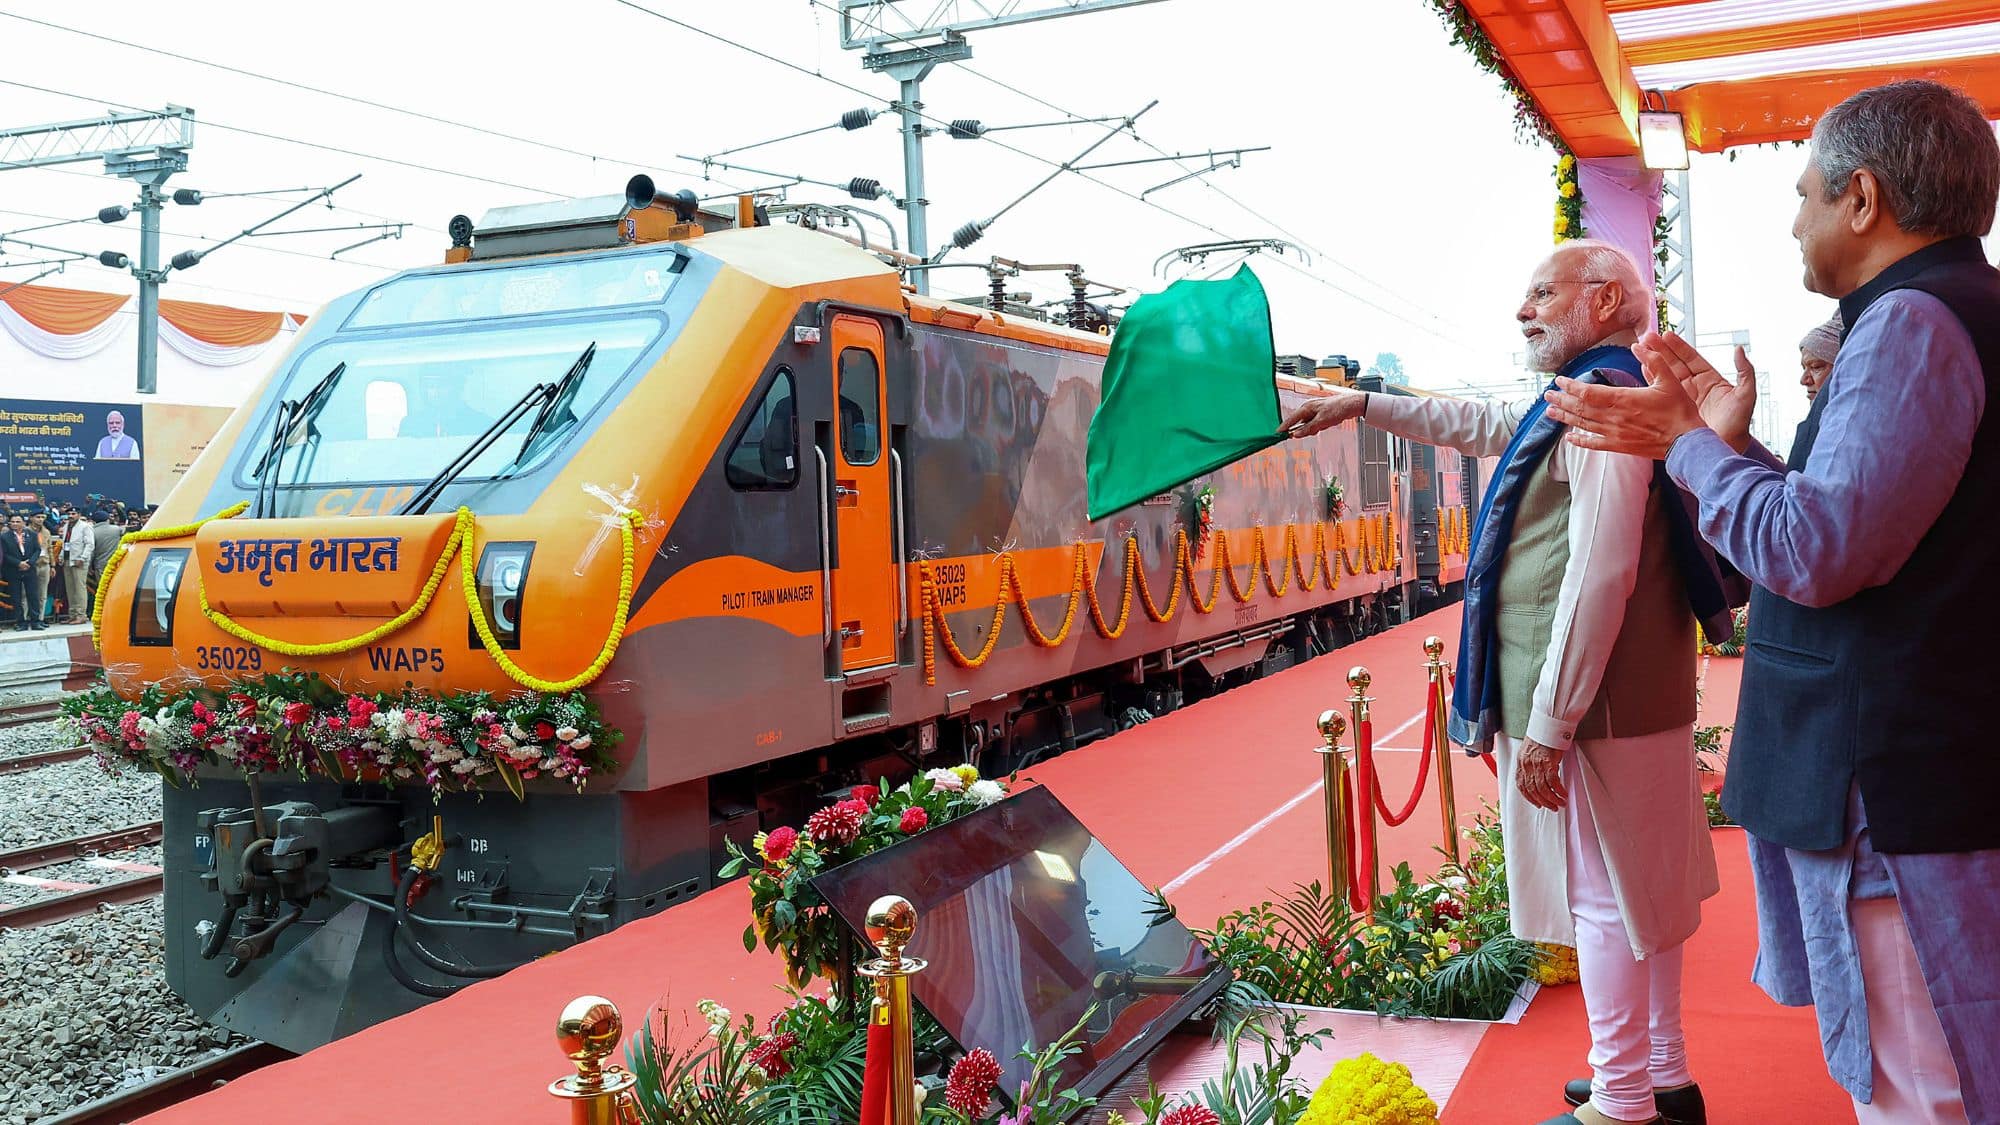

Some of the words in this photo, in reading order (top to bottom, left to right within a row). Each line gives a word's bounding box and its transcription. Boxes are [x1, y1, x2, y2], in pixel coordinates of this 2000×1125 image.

[19, 426, 39, 435] भारत
[40, 425, 50, 435] की
[214, 538, 302, 587] अमृत
[309, 537, 402, 573] भारत
[935, 564, 966, 586] 35029
[722, 592, 746, 610] PILOT
[751, 589, 775, 607] TRAIN
[776, 585, 814, 604] MANAGER
[196, 646, 262, 671] 35029
[367, 647, 445, 673] WAP5
[195, 836, 210, 848] FP
